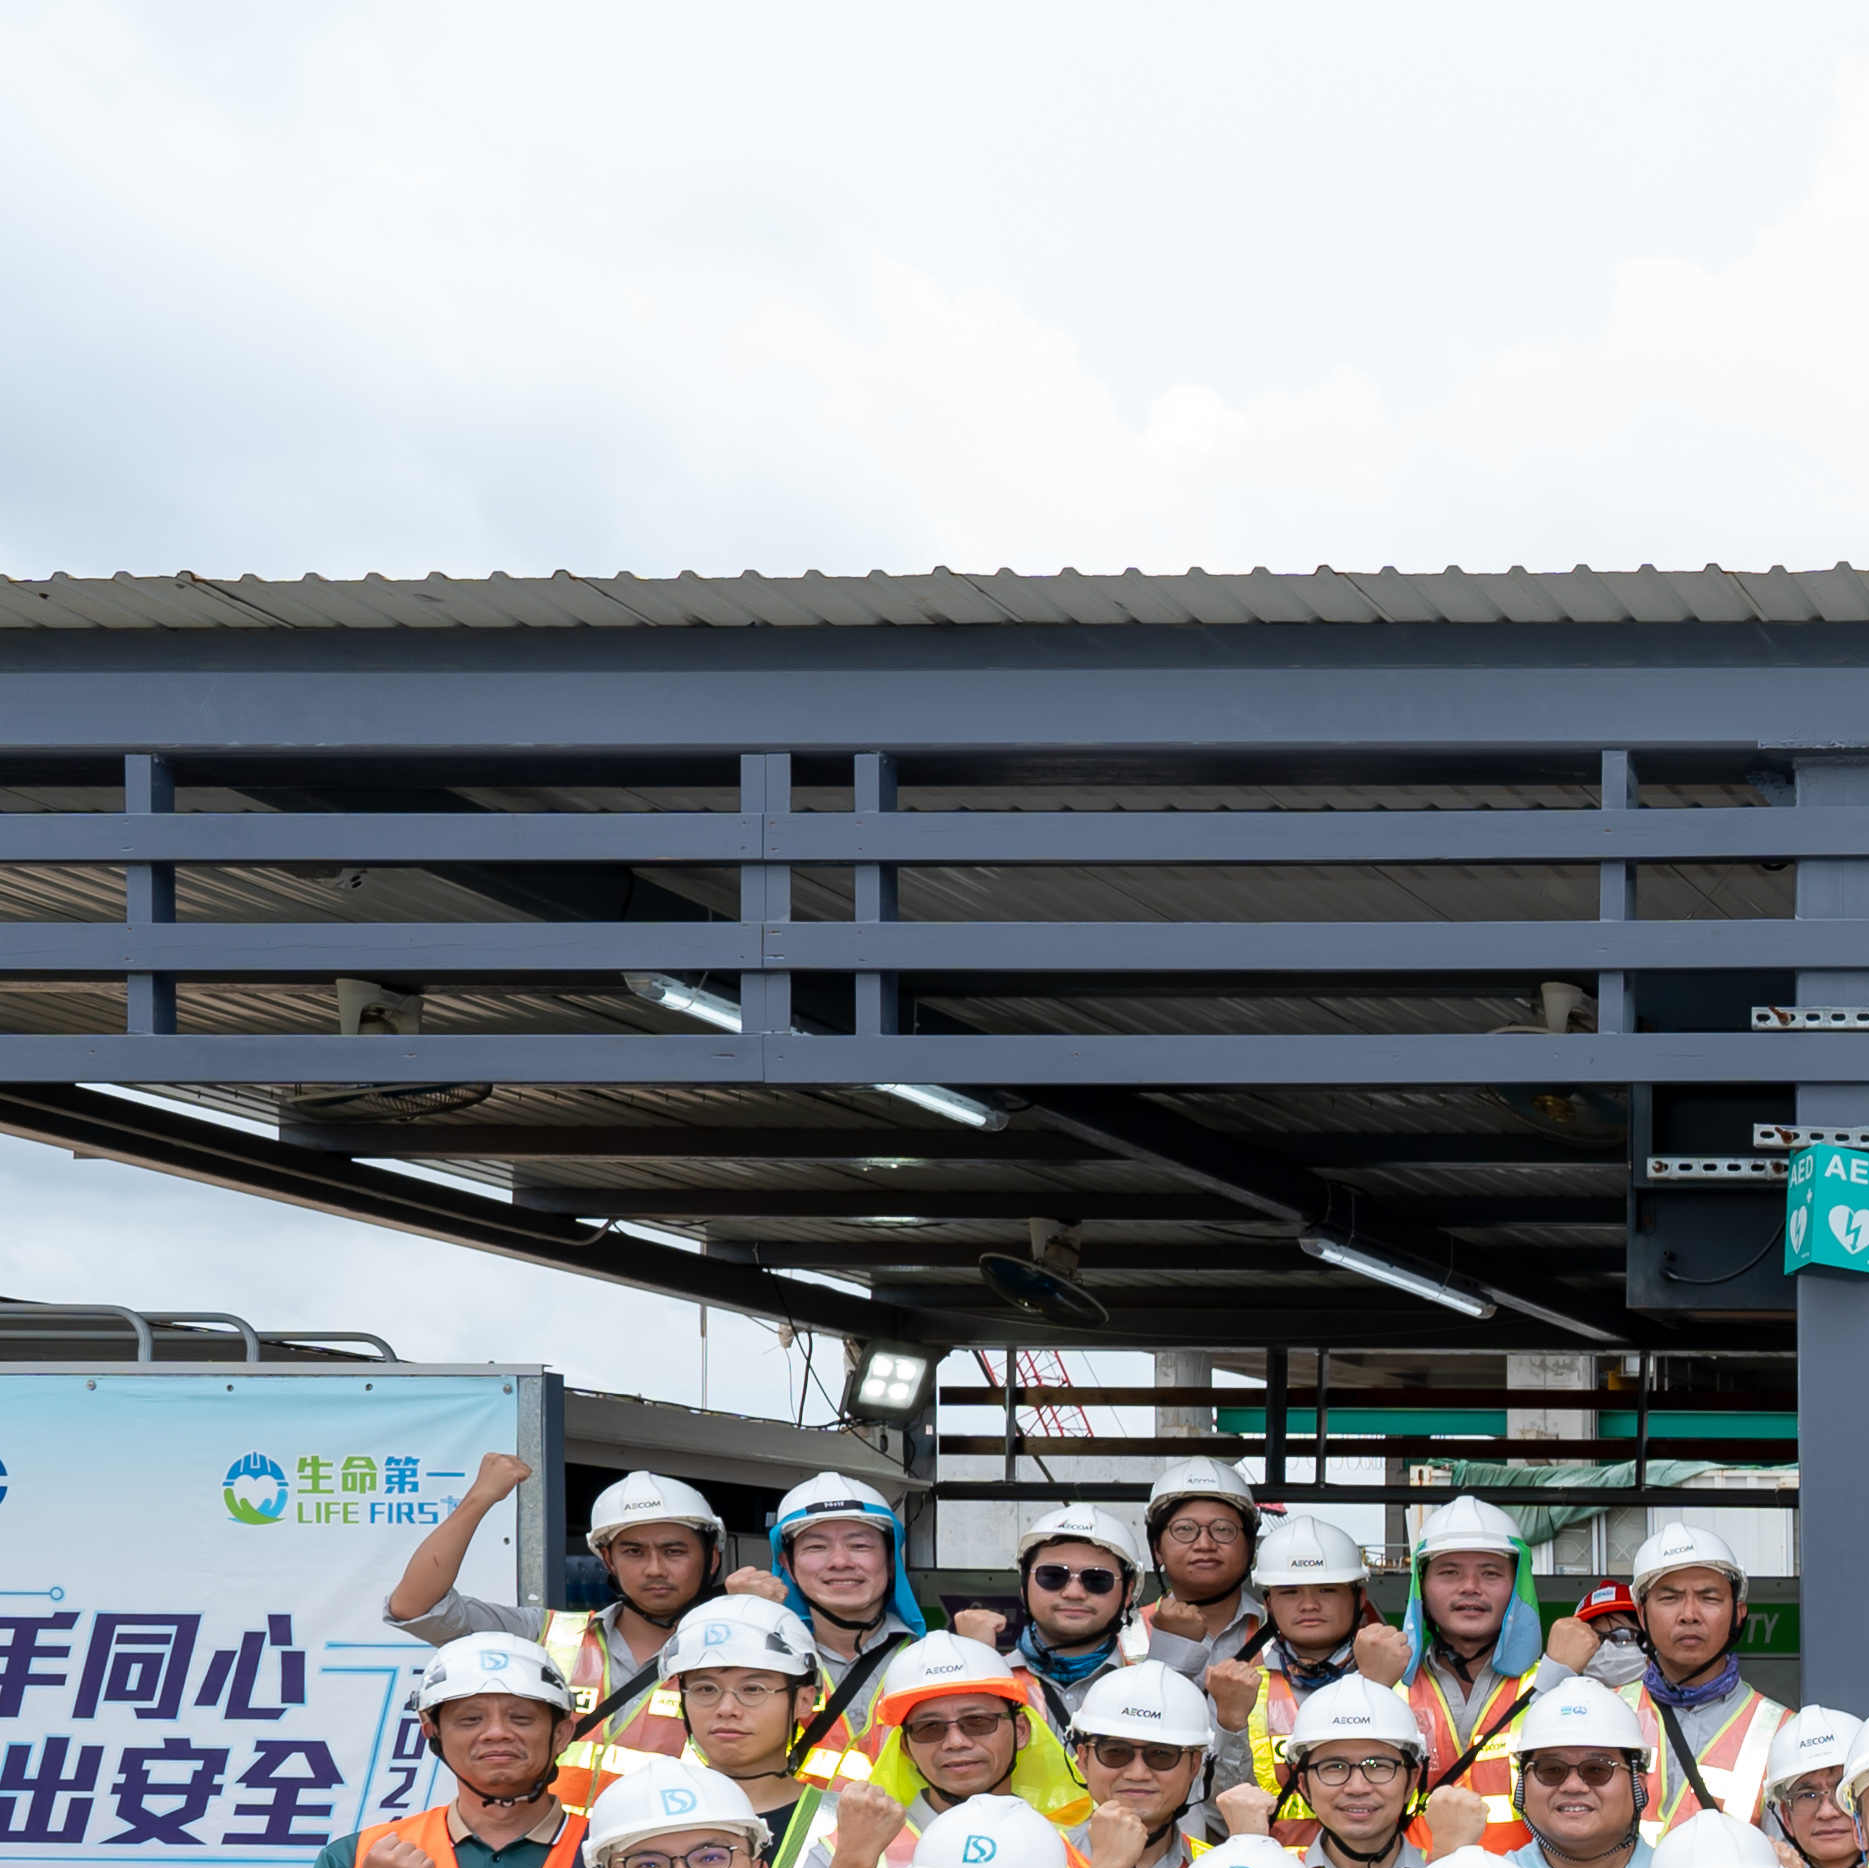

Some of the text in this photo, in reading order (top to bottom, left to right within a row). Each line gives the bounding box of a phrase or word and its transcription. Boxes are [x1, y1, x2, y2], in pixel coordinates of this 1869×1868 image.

[1789, 1154, 1814, 1188] AED
[297, 1455, 466, 1495] 生命第一
[624, 1500, 662, 1511] AECOM
[297, 1501, 359, 1524] LIFE
[1664, 1545, 1695, 1557] AECOM
[1291, 1559, 1324, 1568] AECOM
[926, 1664, 963, 1675] AECOM
[1121, 1707, 1162, 1719] AECOM
[1333, 1716, 1371, 1725] AECOM
[1800, 1734, 1835, 1750] AECOM
[0, 1735, 344, 1846] 出安全
